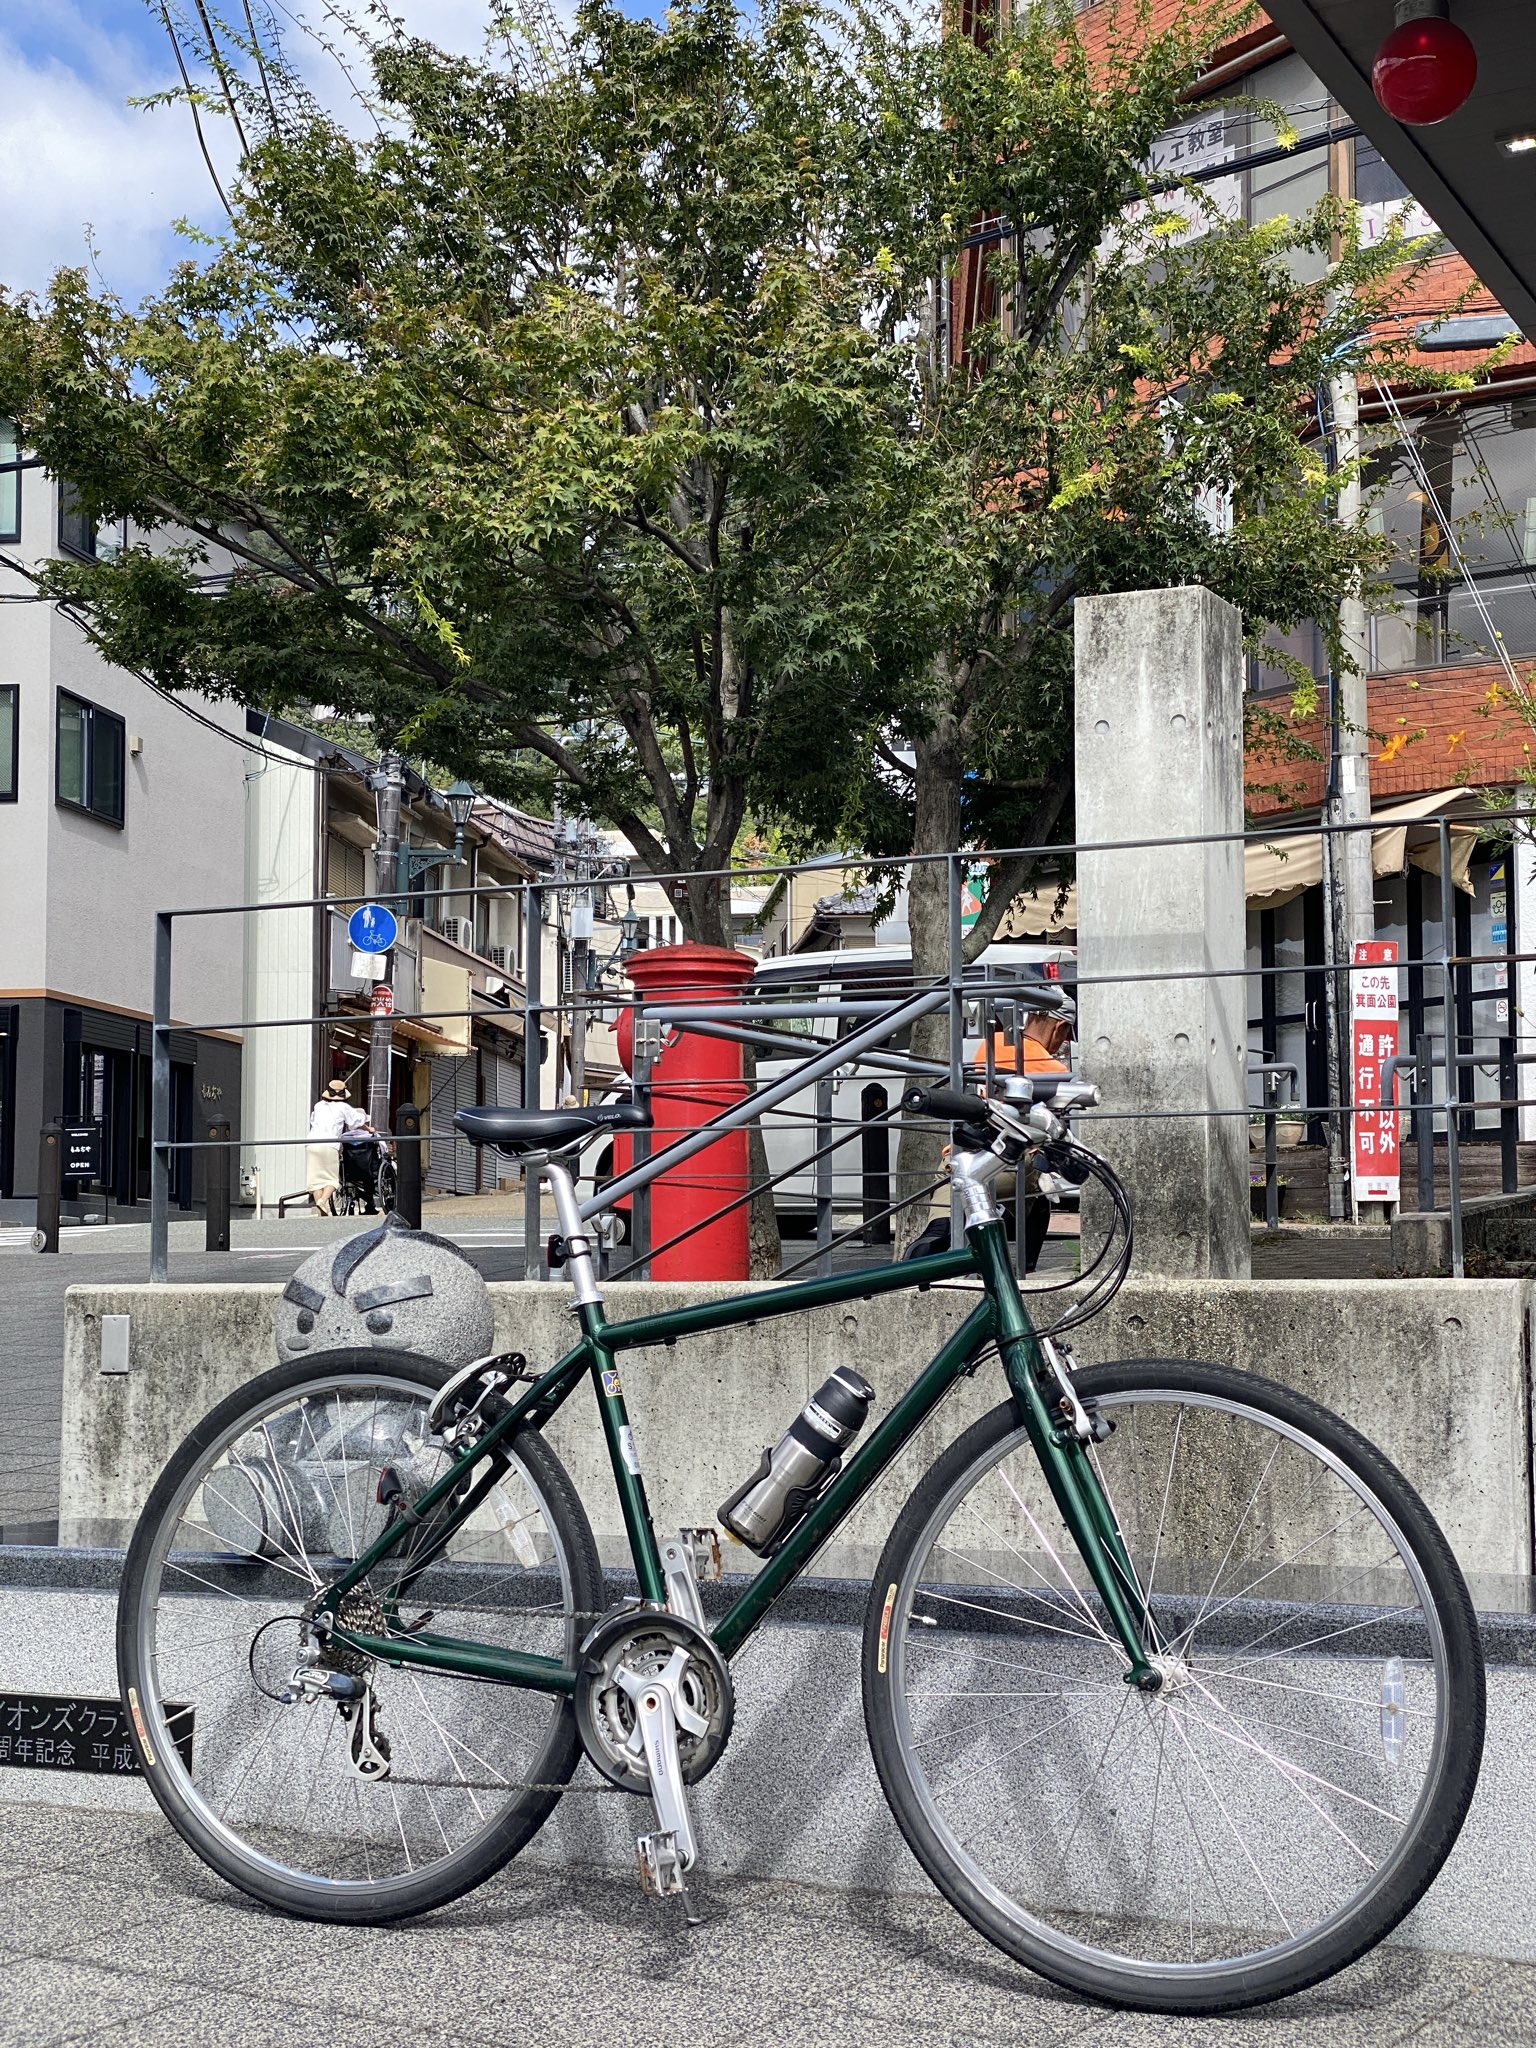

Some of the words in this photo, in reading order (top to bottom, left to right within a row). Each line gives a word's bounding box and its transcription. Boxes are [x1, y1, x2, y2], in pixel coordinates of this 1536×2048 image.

[1358, 948, 1393, 961] 注意
[1361, 975, 1391, 990] この先
[1355, 993, 1397, 1009] 箕面公園
[1358, 1033, 1376, 1155] 通行不可
[1377, 1034, 1396, 1155] 許以外
[0, 1735, 76, 1766] 周年記念
[90, 1742, 141, 1770] 平成
[654, 1739, 664, 1776] SHIMANO
